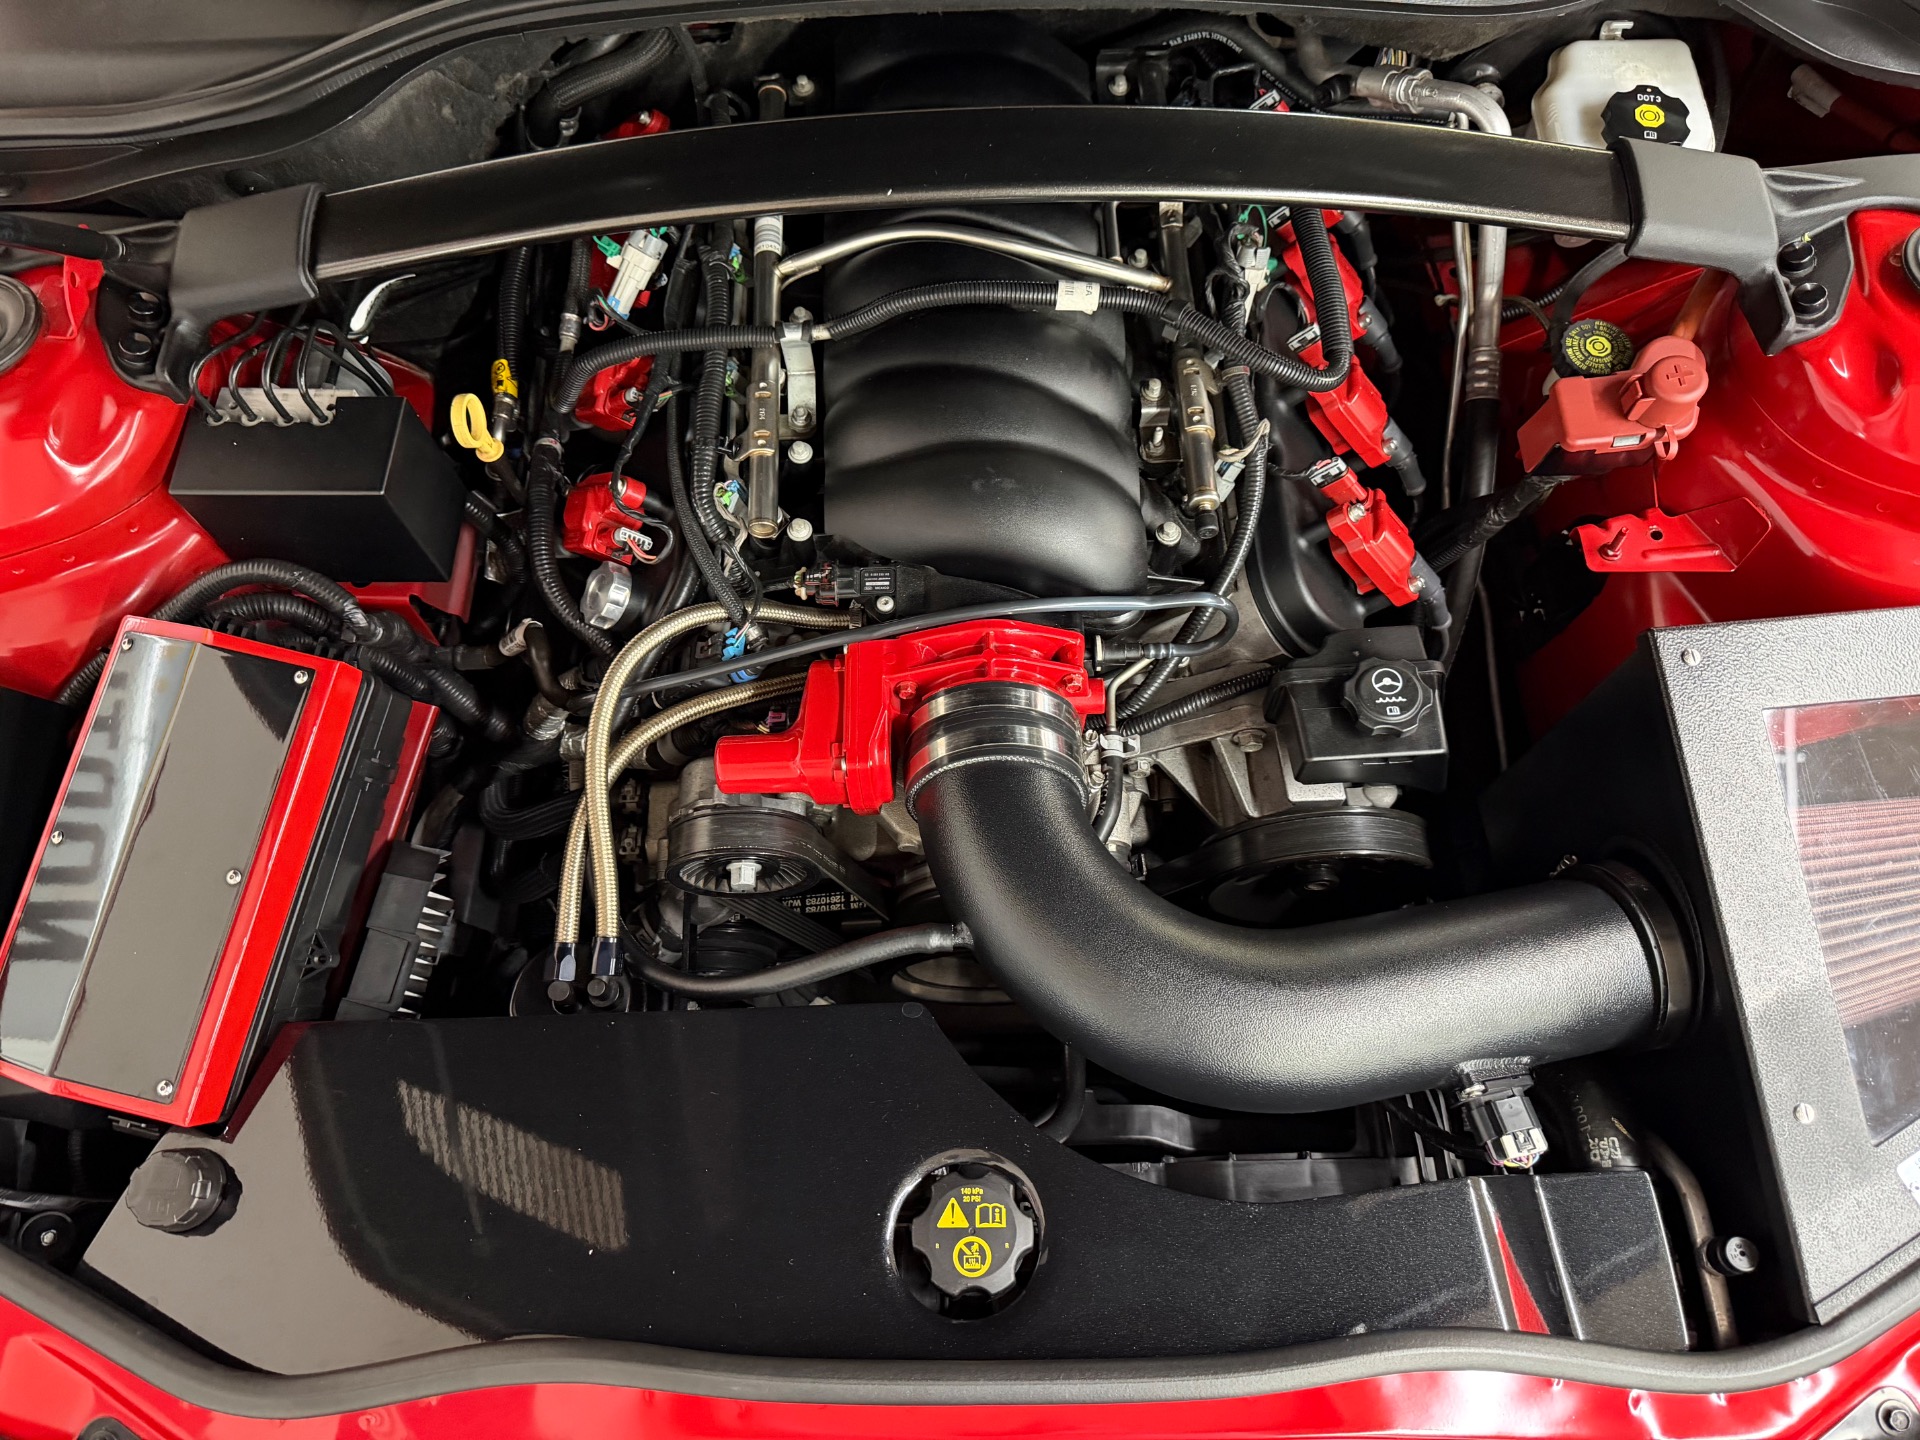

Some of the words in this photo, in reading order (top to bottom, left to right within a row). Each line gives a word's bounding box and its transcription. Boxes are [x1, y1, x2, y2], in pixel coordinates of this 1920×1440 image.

[1637, 94, 1655, 102] DOT
[1655, 95, 1661, 103] 3
[805, 894, 846, 906] 12610783
[805, 903, 846, 914] 12610783
[960, 1187, 971, 1195] 140
[971, 1187, 984, 1195] kPa
